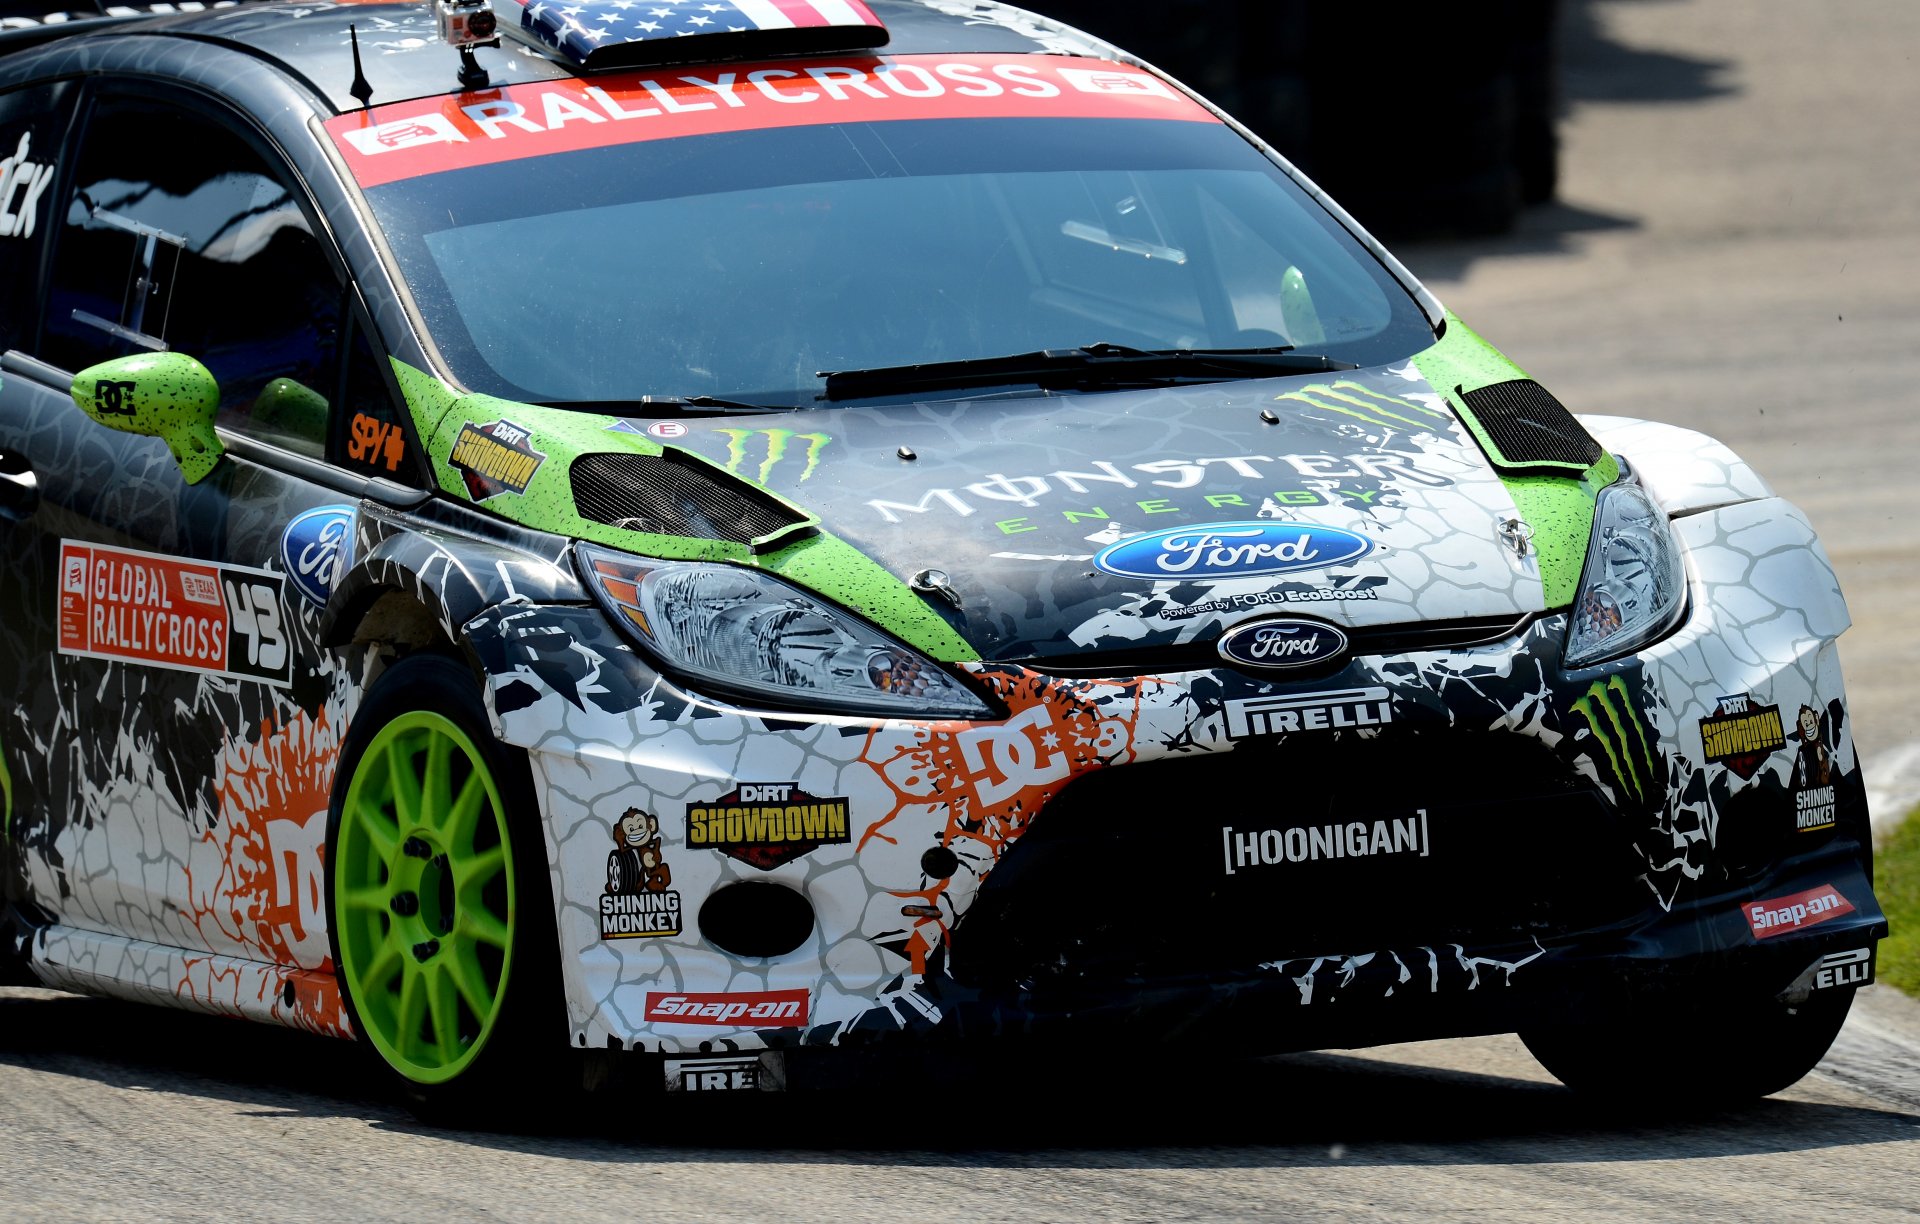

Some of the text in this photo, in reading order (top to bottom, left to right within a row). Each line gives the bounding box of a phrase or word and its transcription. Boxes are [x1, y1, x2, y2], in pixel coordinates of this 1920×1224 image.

[461, 62, 1061, 139] RALLYCROSS
[95, 379, 137, 416] DC
[658, 424, 678, 435] E
[453, 429, 540, 489] SHOWDOWN
[862, 454, 1454, 524] MONSTER
[995, 489, 1377, 538] ENERGY
[299, 518, 348, 590] Fo
[1156, 528, 1319, 572] Ford
[94, 559, 172, 609] GLOBAL
[1160, 587, 1377, 619] Powered by FORD EcoBoost
[93, 604, 223, 661] RALLYCROSS
[225, 580, 287, 670] 43
[1250, 627, 1320, 658] Ford
[1224, 686, 1392, 737] PIRELLI
[1702, 710, 1784, 758] SHOWDOWN
[956, 704, 1071, 809] DC
[1796, 785, 1835, 810] SHINING
[1796, 803, 1835, 829] MONKEY
[690, 804, 846, 843] SHOWDOWN
[601, 893, 678, 914] SHINING
[602, 912, 679, 934] MONKEY
[1751, 894, 1841, 929] Snap-on
[650, 996, 800, 1022] Snap-on
